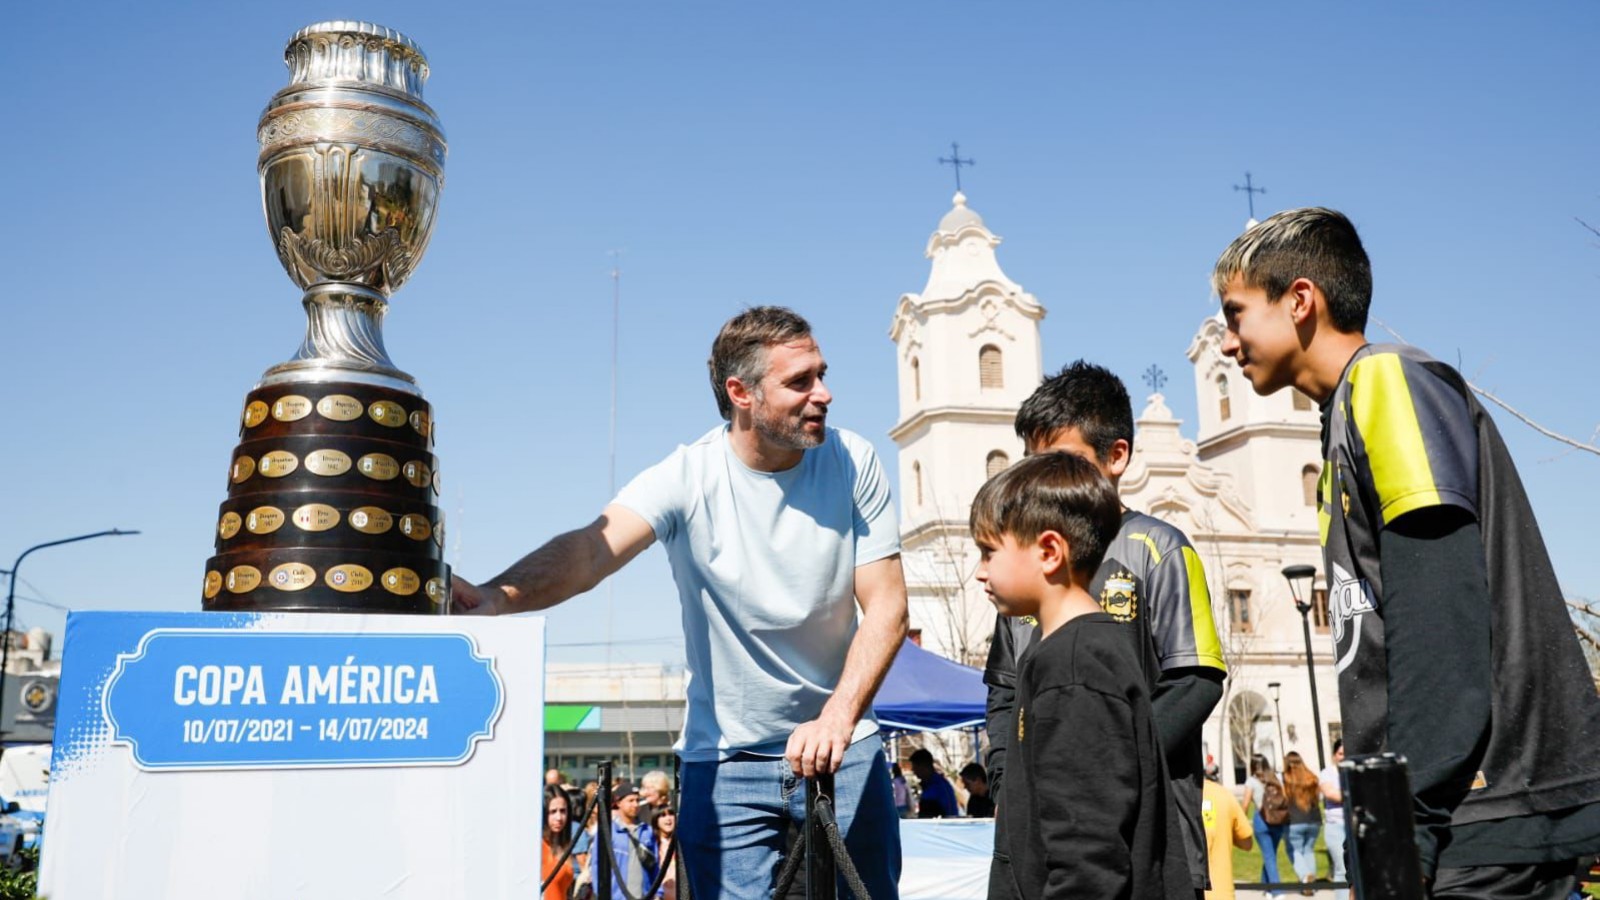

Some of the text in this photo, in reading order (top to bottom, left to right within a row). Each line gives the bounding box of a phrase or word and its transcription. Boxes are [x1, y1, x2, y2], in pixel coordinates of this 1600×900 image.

[174, 656, 440, 706] COPA AMÉRICA
[183, 718, 293, 744] 10/07/2021
[318, 716, 429, 743] 14/07/2024
